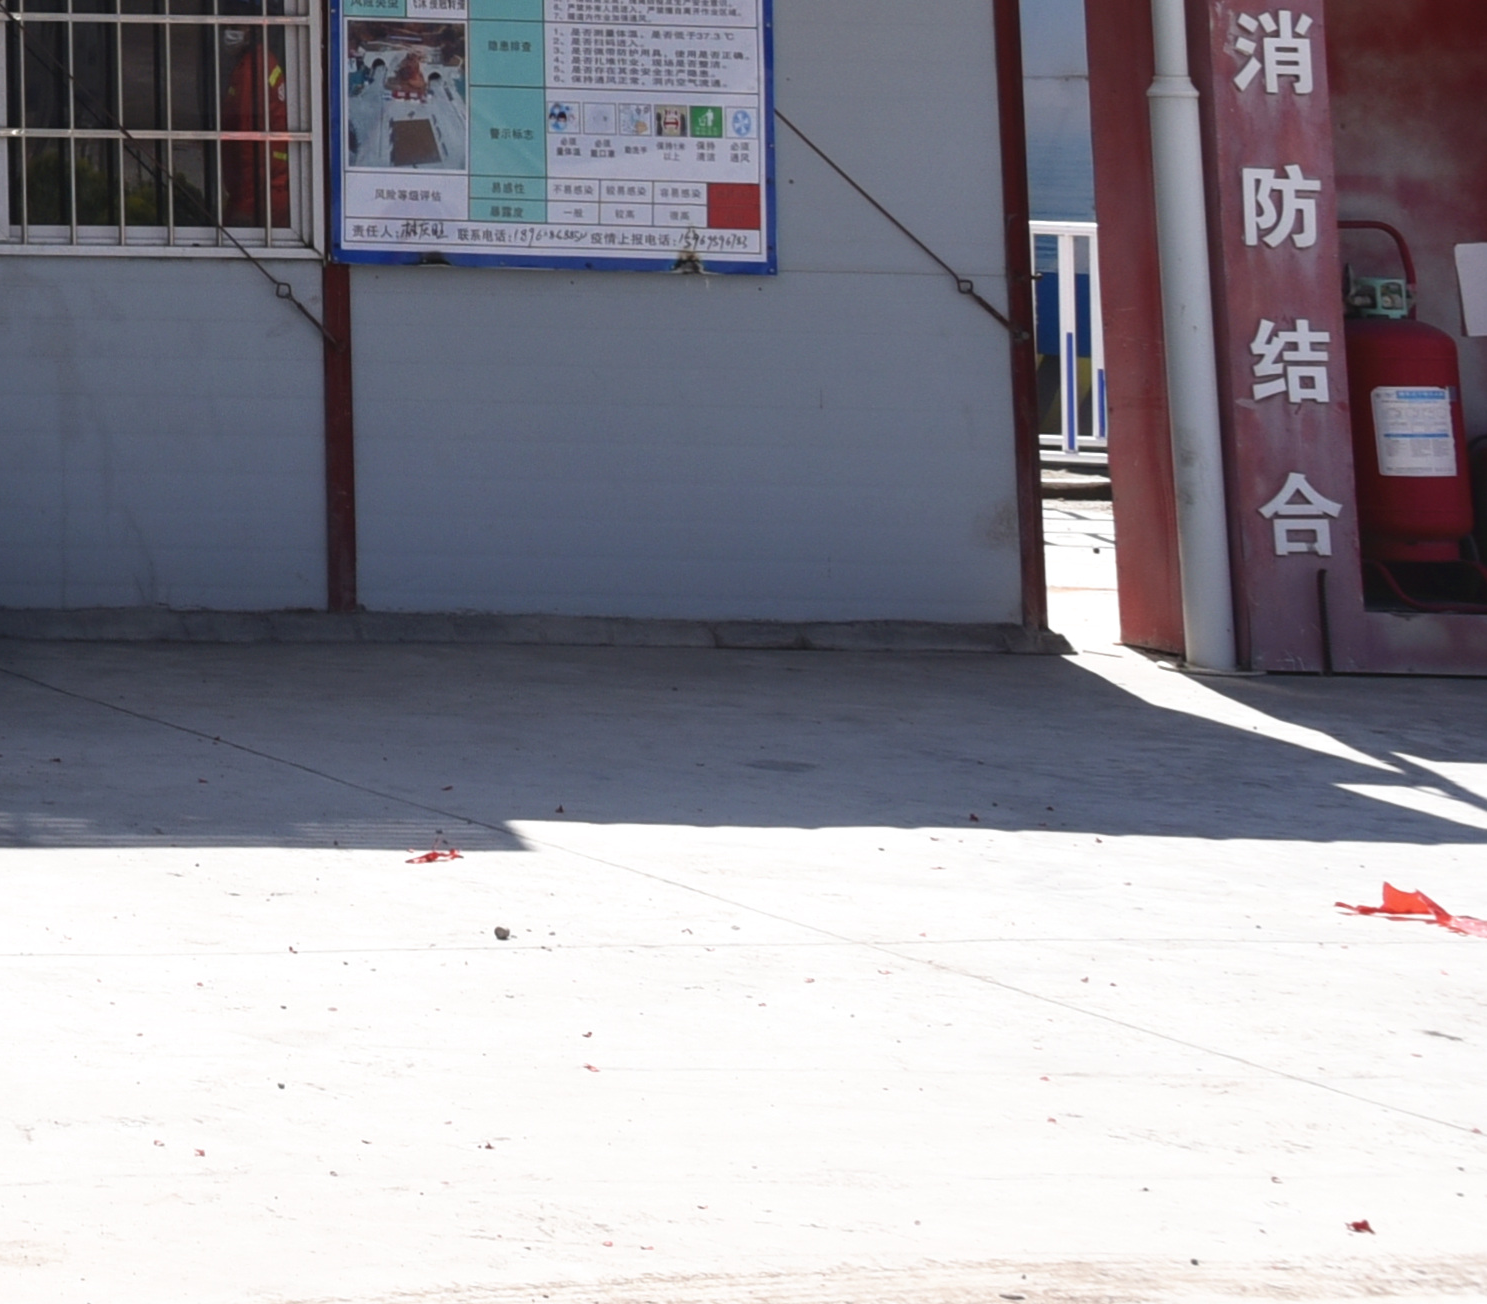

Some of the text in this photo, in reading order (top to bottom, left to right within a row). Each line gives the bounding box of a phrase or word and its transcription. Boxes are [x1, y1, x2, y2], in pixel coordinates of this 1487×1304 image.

[487, 39, 532, 52] 隐患排查
[489, 128, 534, 142] 警示标志
[374, 188, 442, 202] 风险等级评估
[491, 181, 525, 195] 易感性
[491, 205, 524, 218] 暴露度
[1233, 8, 1343, 558] 消防结合
